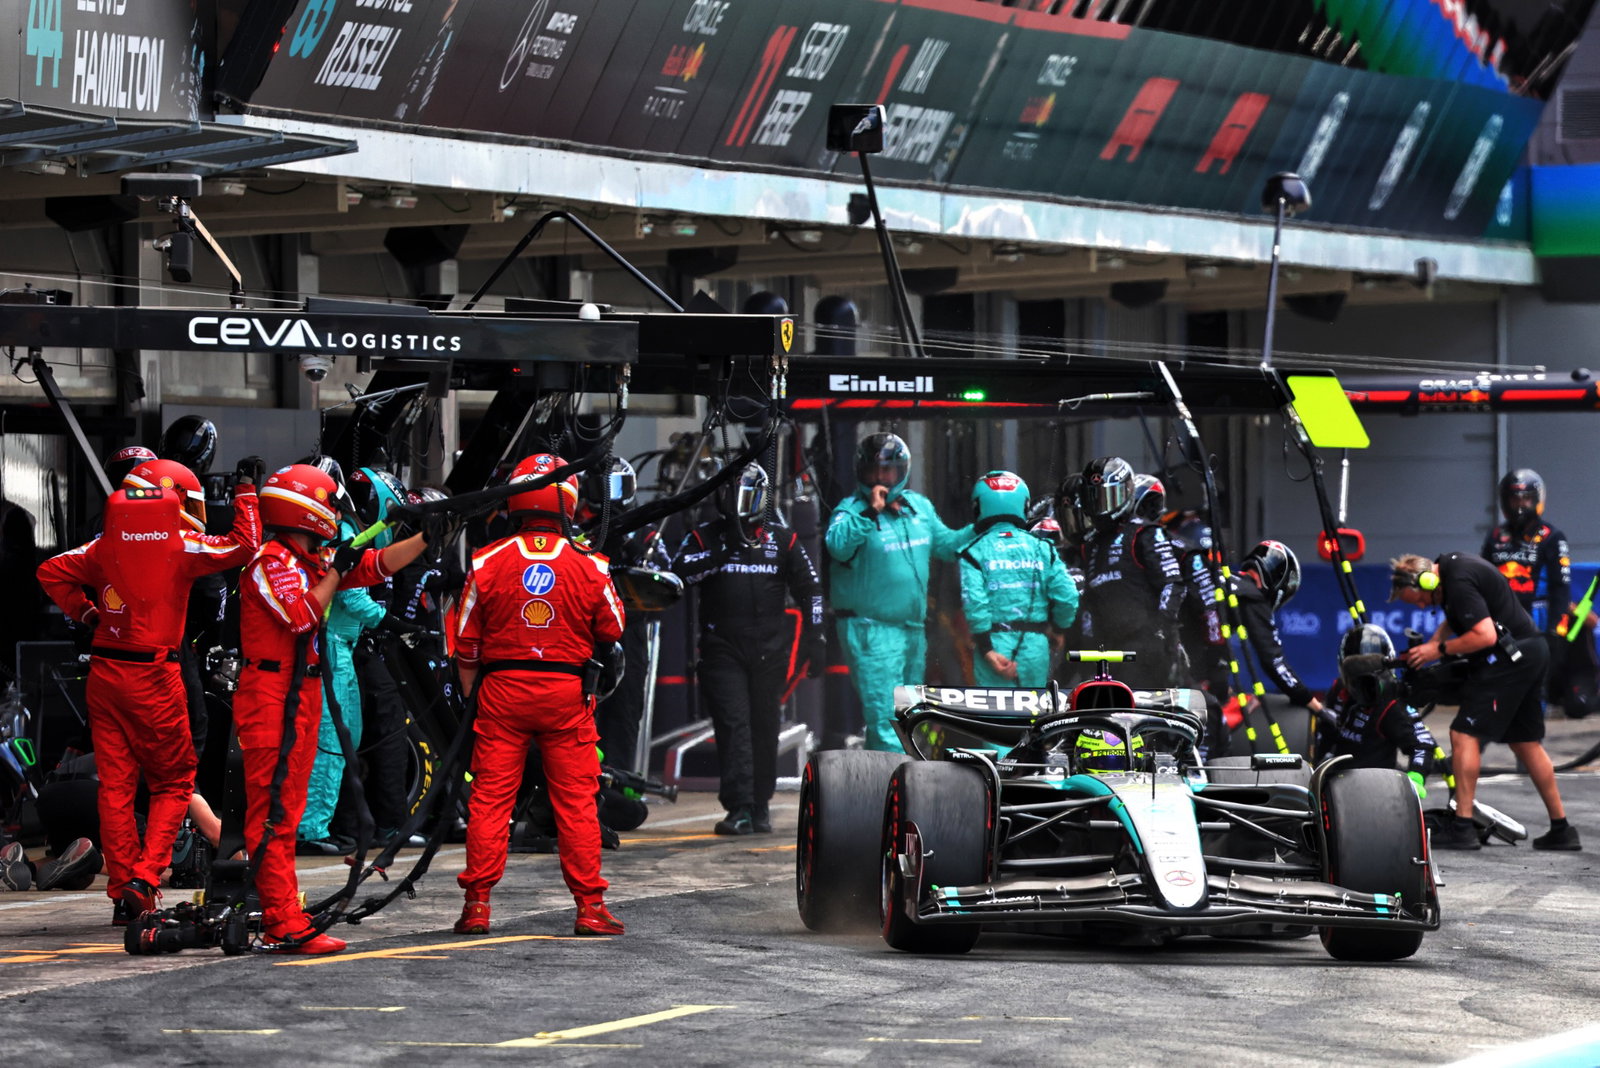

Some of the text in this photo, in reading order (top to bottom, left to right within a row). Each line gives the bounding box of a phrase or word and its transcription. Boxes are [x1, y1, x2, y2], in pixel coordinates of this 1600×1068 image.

[314, 21, 402, 91] RUSSELL
[72, 29, 165, 113] HAMILTON
[327, 332, 462, 351] LOGISTICS
[829, 374, 934, 393] Einhell
[121, 530, 169, 541] brembo
[526, 564, 552, 594] hp
[1337, 611, 1403, 634] PRC
[1097, 750, 1126, 758] PETRONA
